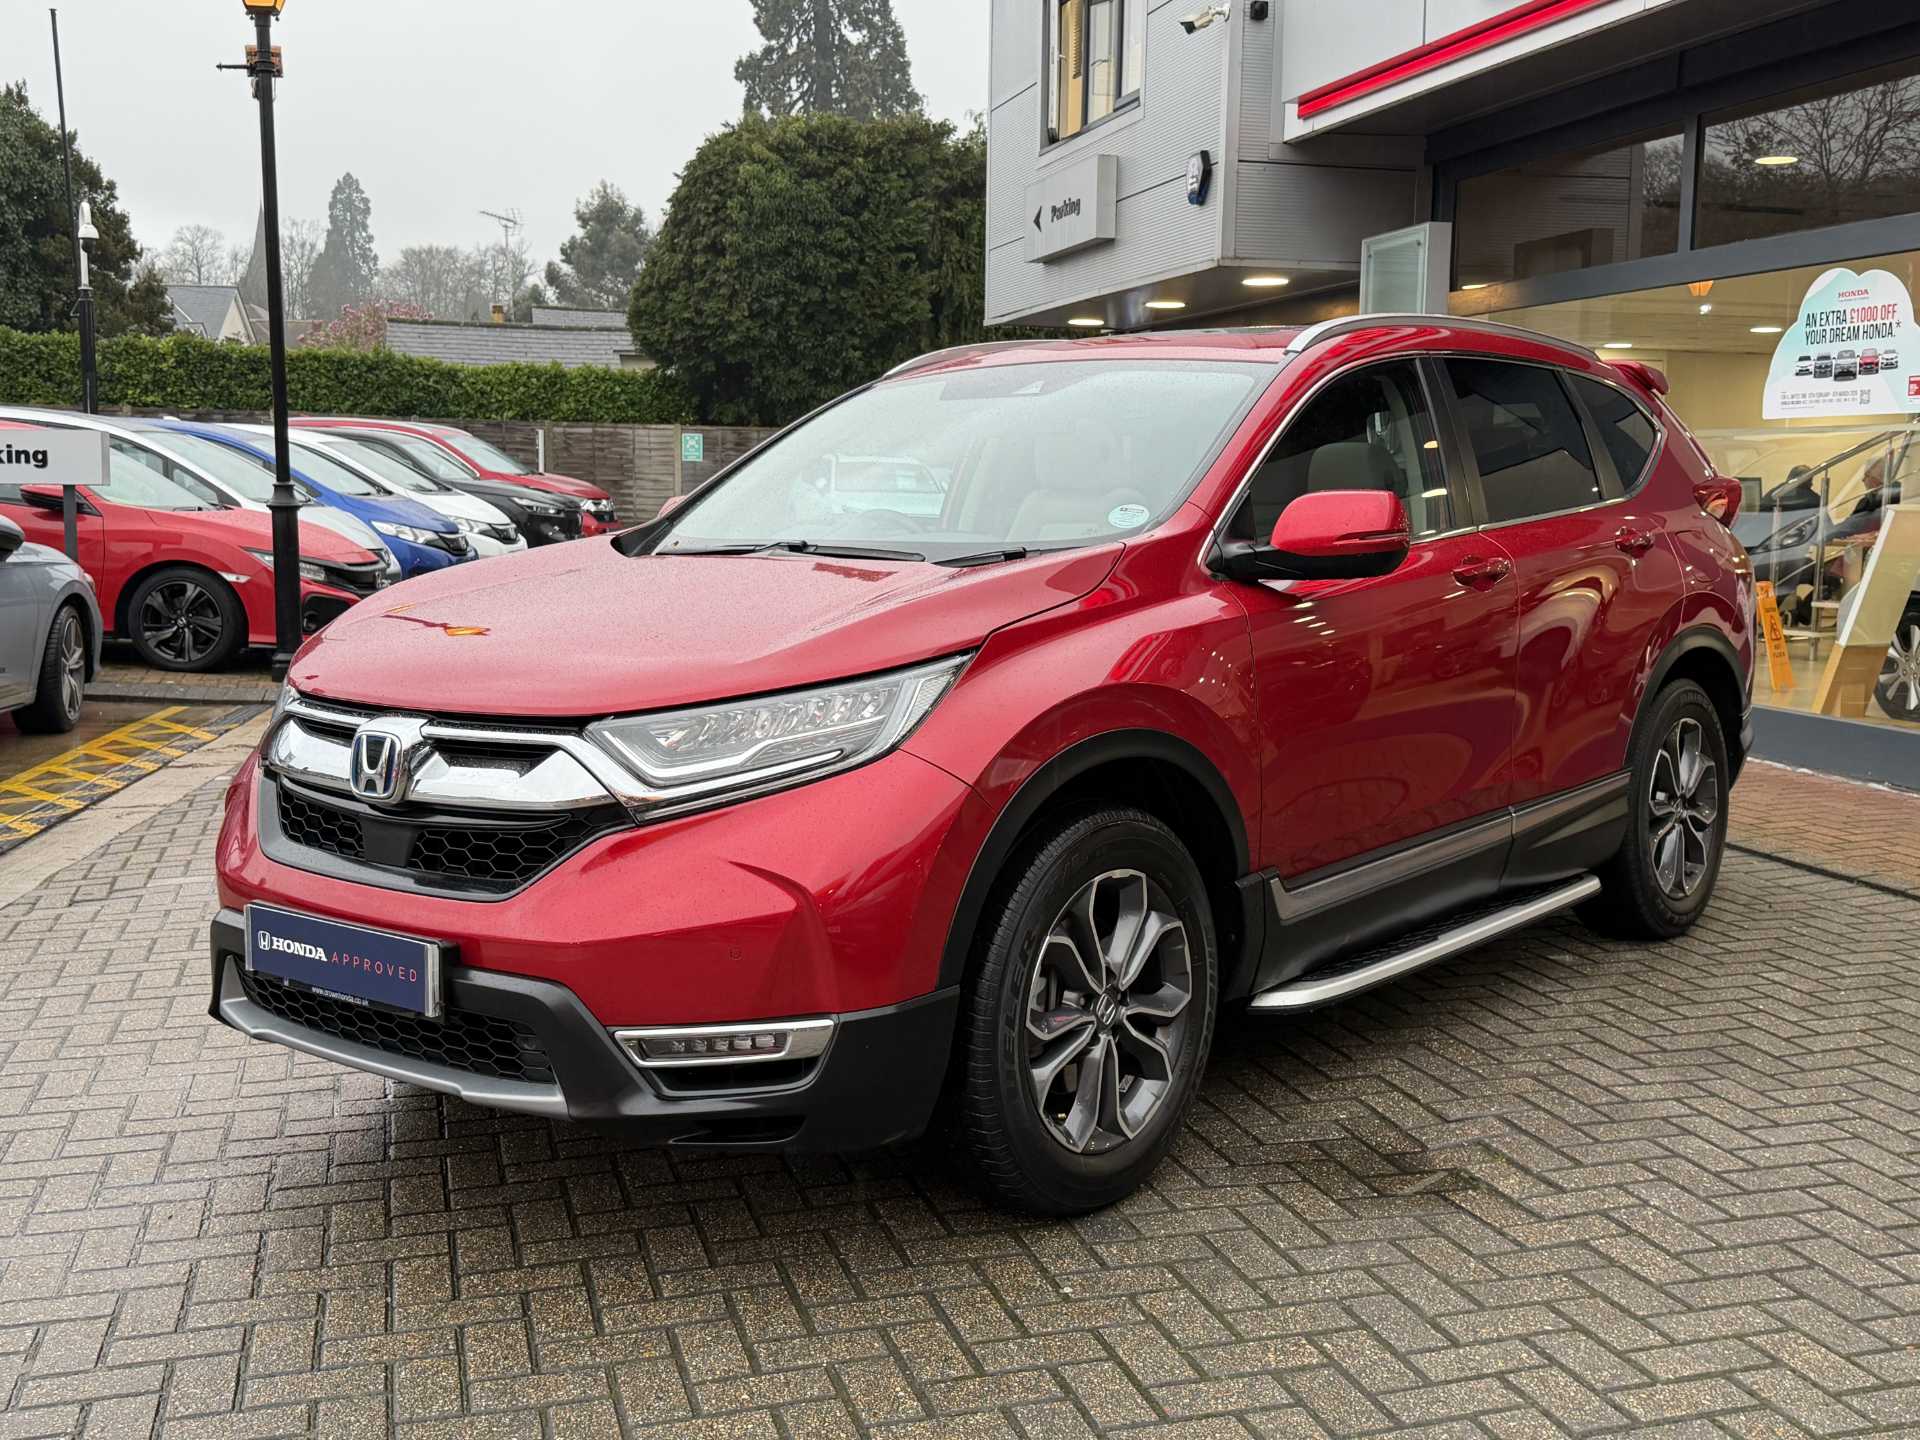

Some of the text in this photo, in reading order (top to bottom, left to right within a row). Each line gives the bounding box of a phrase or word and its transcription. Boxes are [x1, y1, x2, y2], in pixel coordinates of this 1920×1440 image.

[1051, 197, 1081, 223] Parking
[1838, 289, 1870, 298] HONDA
[1805, 303, 1898, 329] AN EXTRA £1000 OFF
[1805, 328, 1827, 346] YOUR
[1829, 325, 1860, 343] DREAM
[272, 936, 328, 962] HONDA
[331, 952, 418, 983] APPROVED
